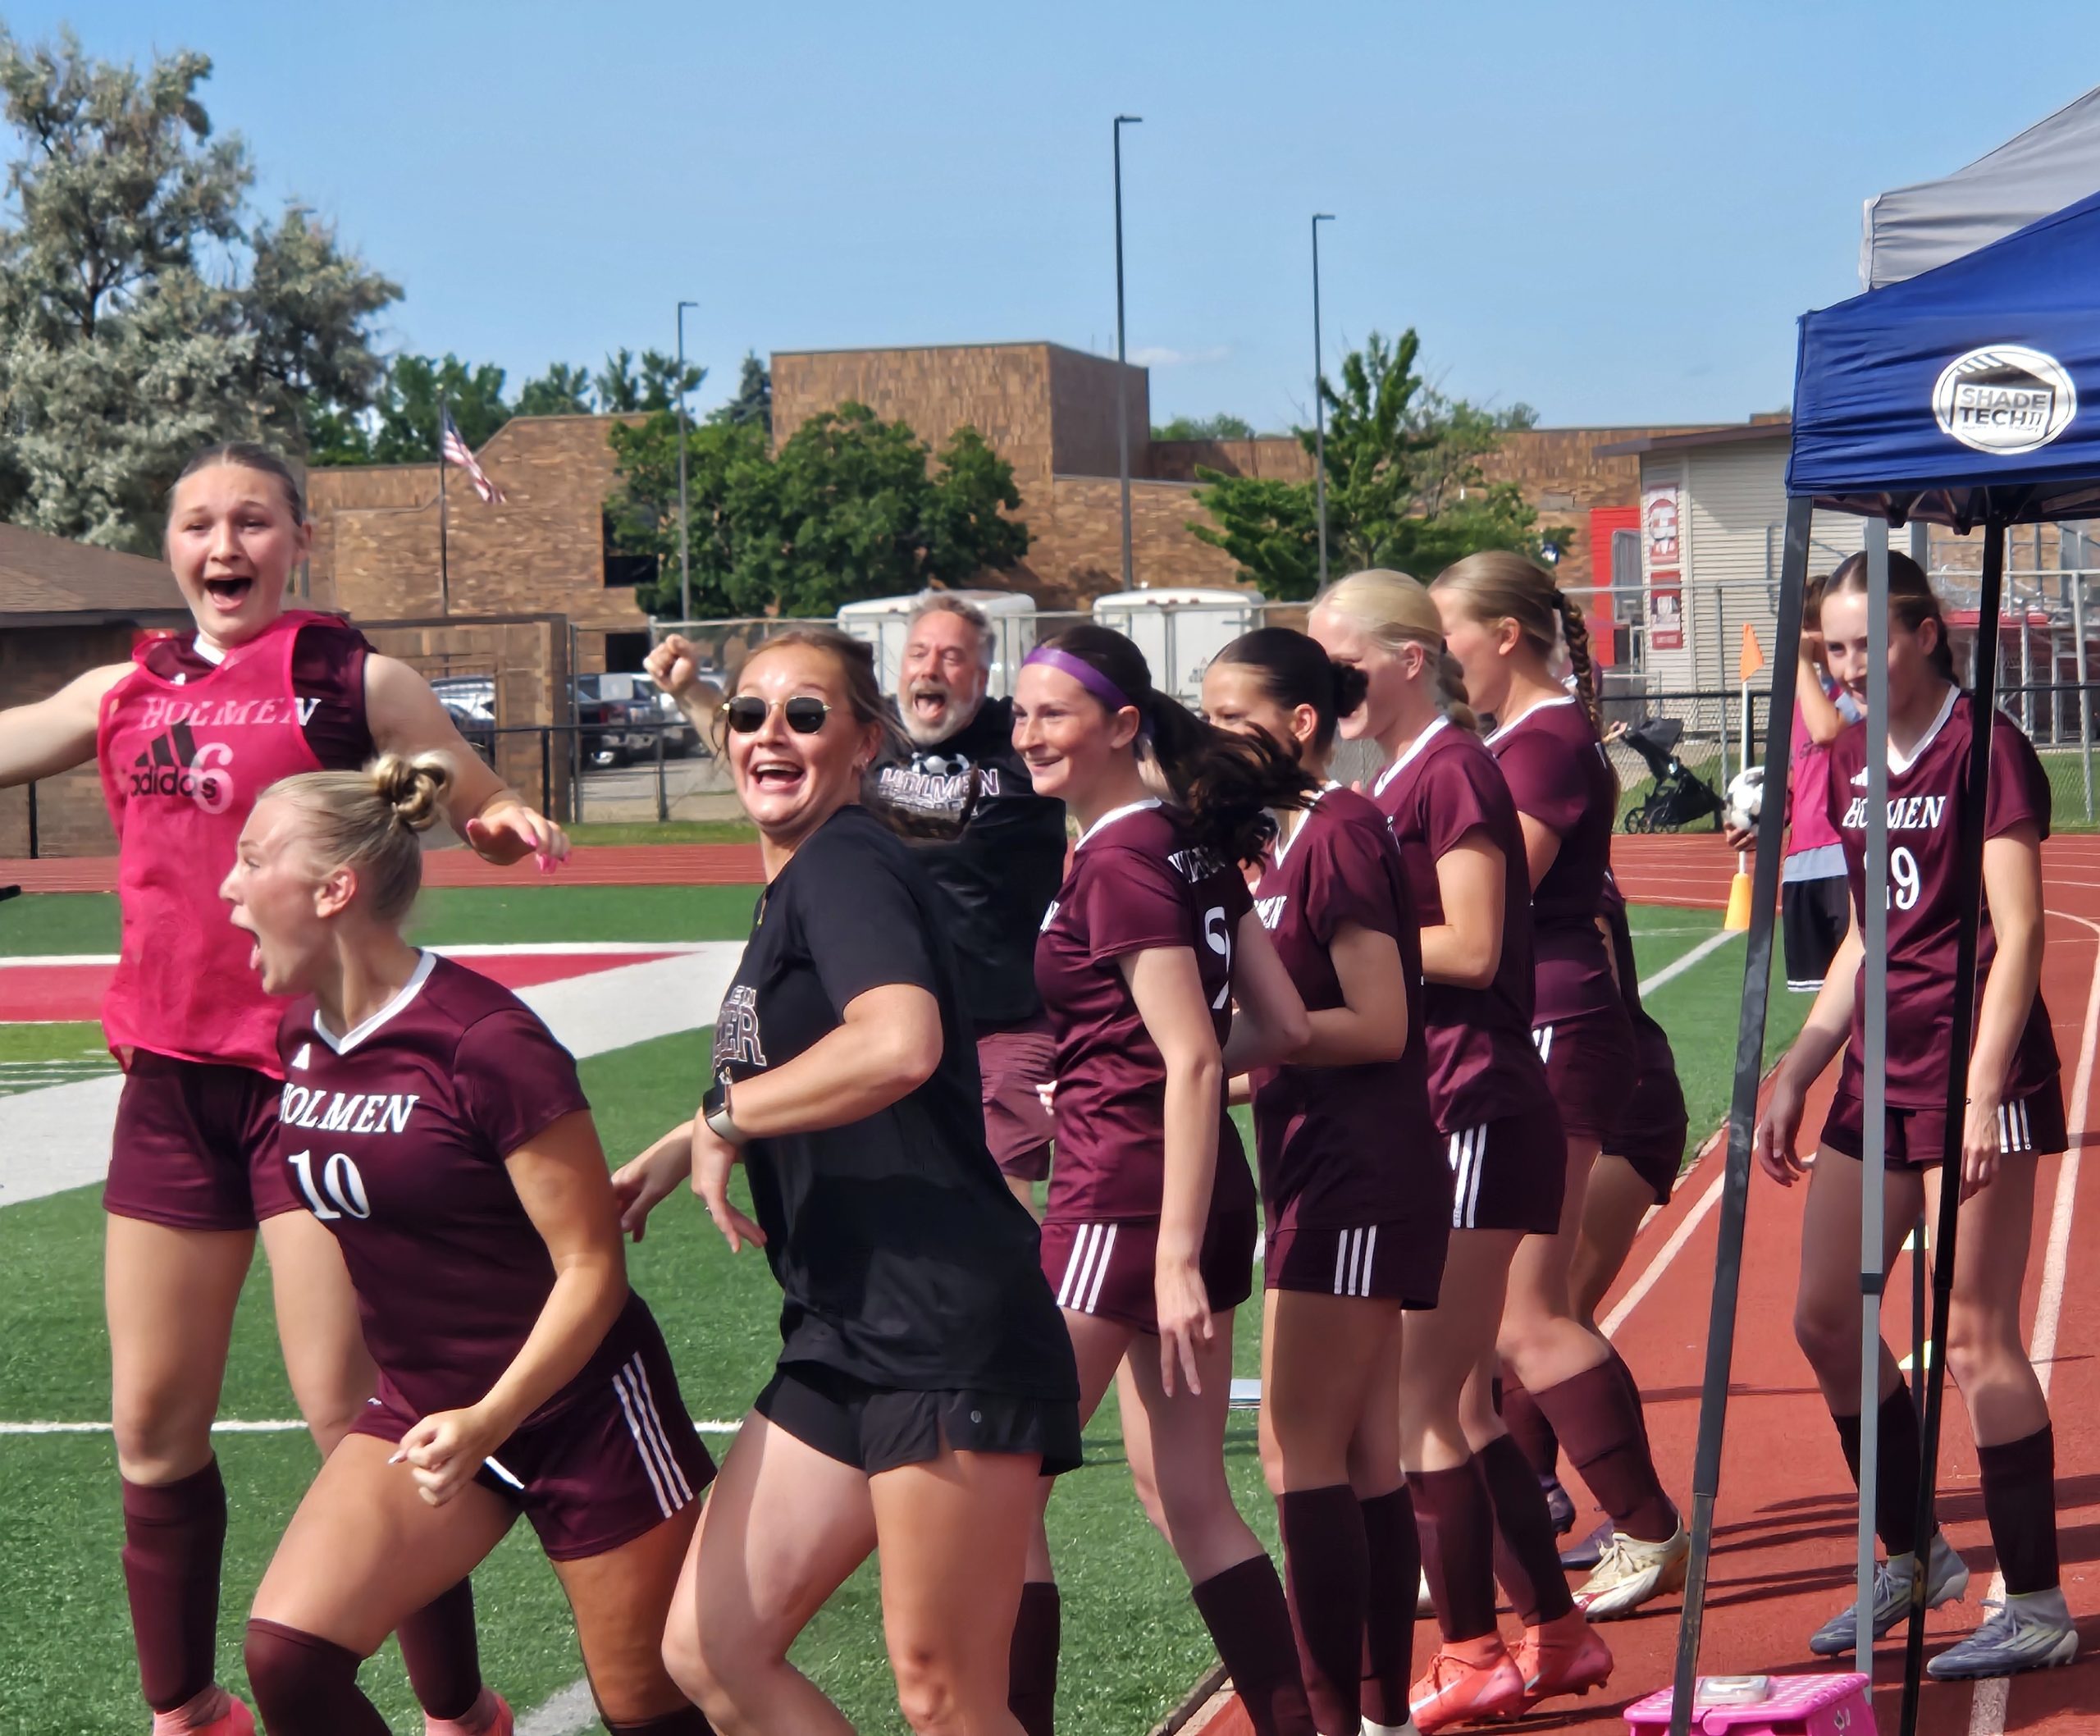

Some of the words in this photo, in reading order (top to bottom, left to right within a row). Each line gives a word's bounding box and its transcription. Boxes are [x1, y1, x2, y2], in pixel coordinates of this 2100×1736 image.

[1961, 387, 2048, 410] SHADE
[139, 697, 322, 731] HOLMEN
[189, 742, 235, 815] 6
[288, 1149, 371, 1220] 10
